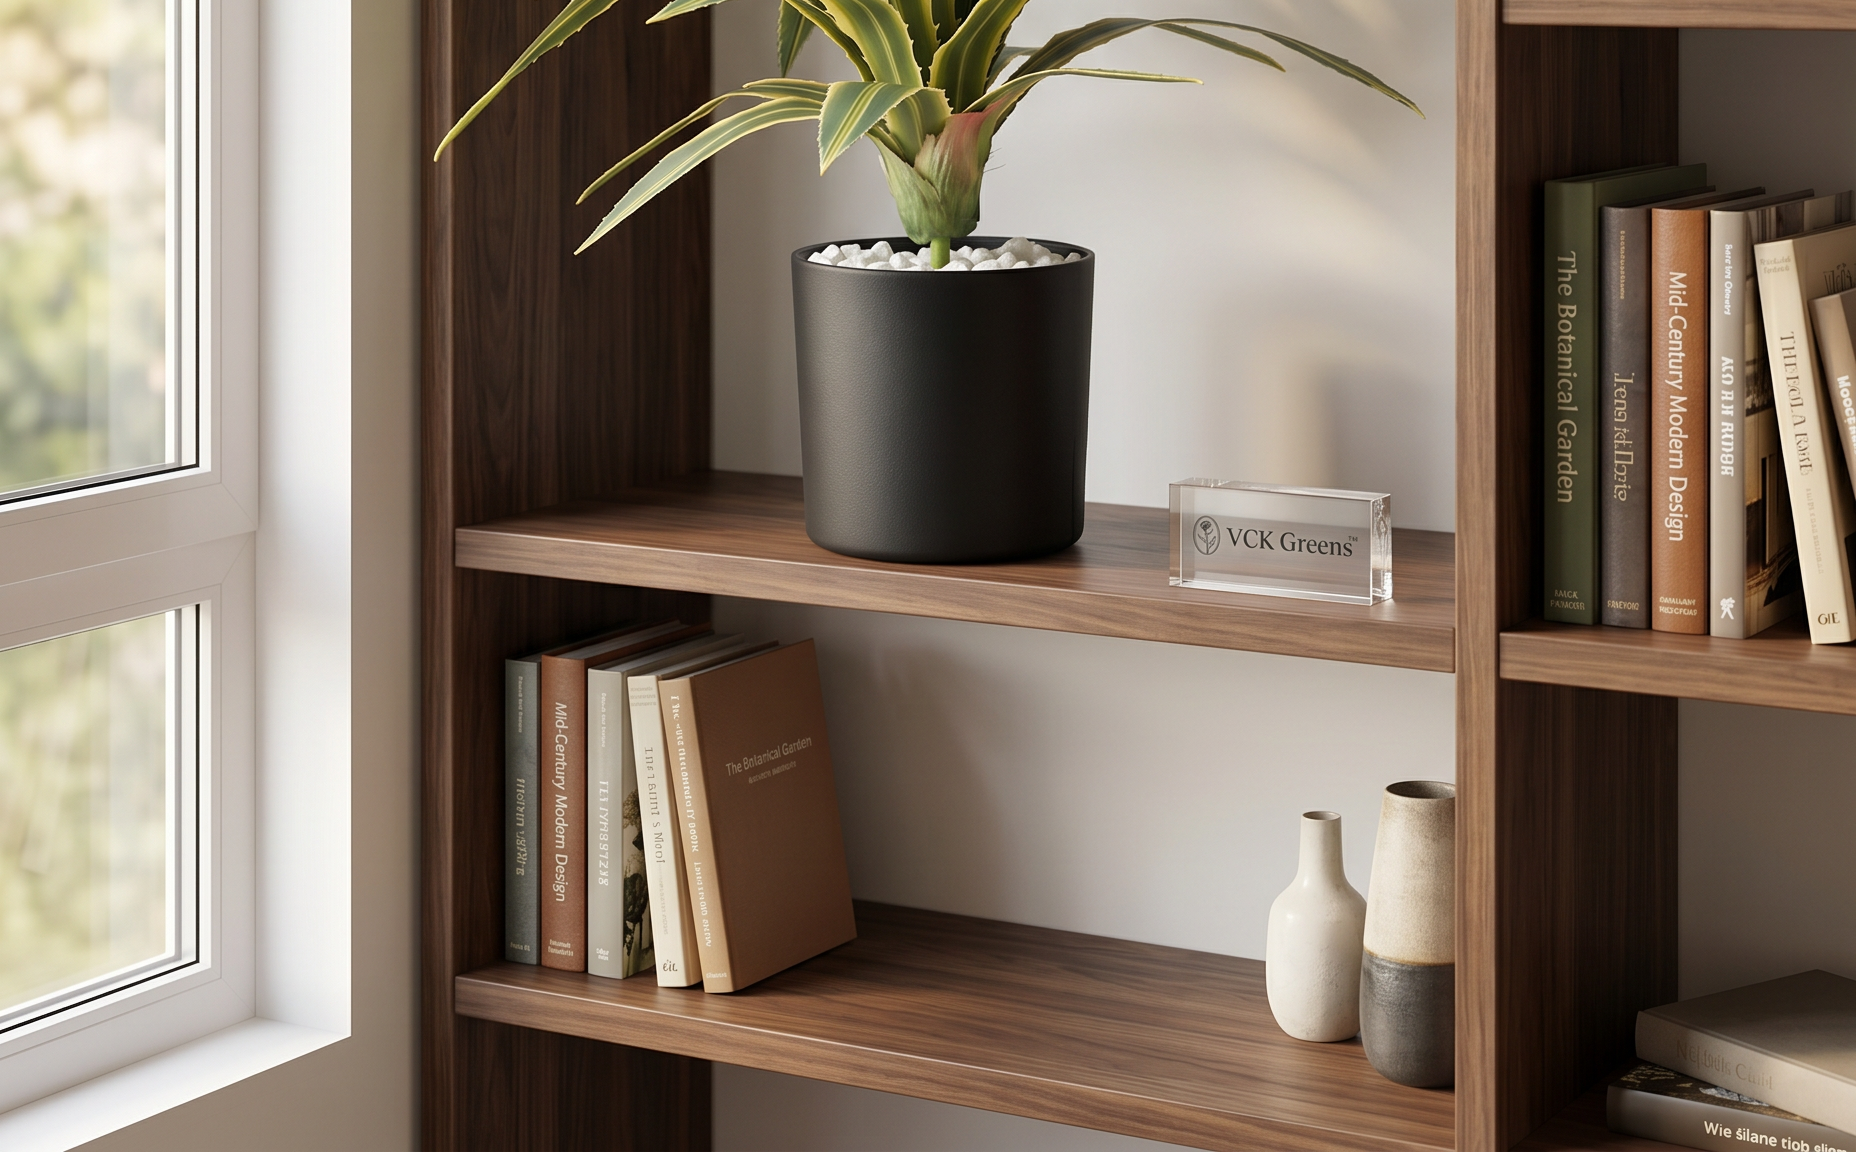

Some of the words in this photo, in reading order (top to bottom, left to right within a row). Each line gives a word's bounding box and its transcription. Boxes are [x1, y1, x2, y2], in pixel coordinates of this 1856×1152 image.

[1557, 250, 1578, 297] The
[1557, 303, 1579, 411] Botanical
[1664, 271, 1689, 390] Mid-Century
[1668, 395, 1689, 469] Modern
[1556, 419, 1579, 504] Garden
[1664, 476, 1689, 542] Design
[1226, 527, 1275, 551] VCK
[1280, 531, 1353, 557] Greens
[725, 761, 743, 777] The
[781, 736, 813, 756] Garden
[554, 794, 569, 849] Modern
[552, 853, 569, 902] Design
[1703, 1120, 1732, 1138] Wie
